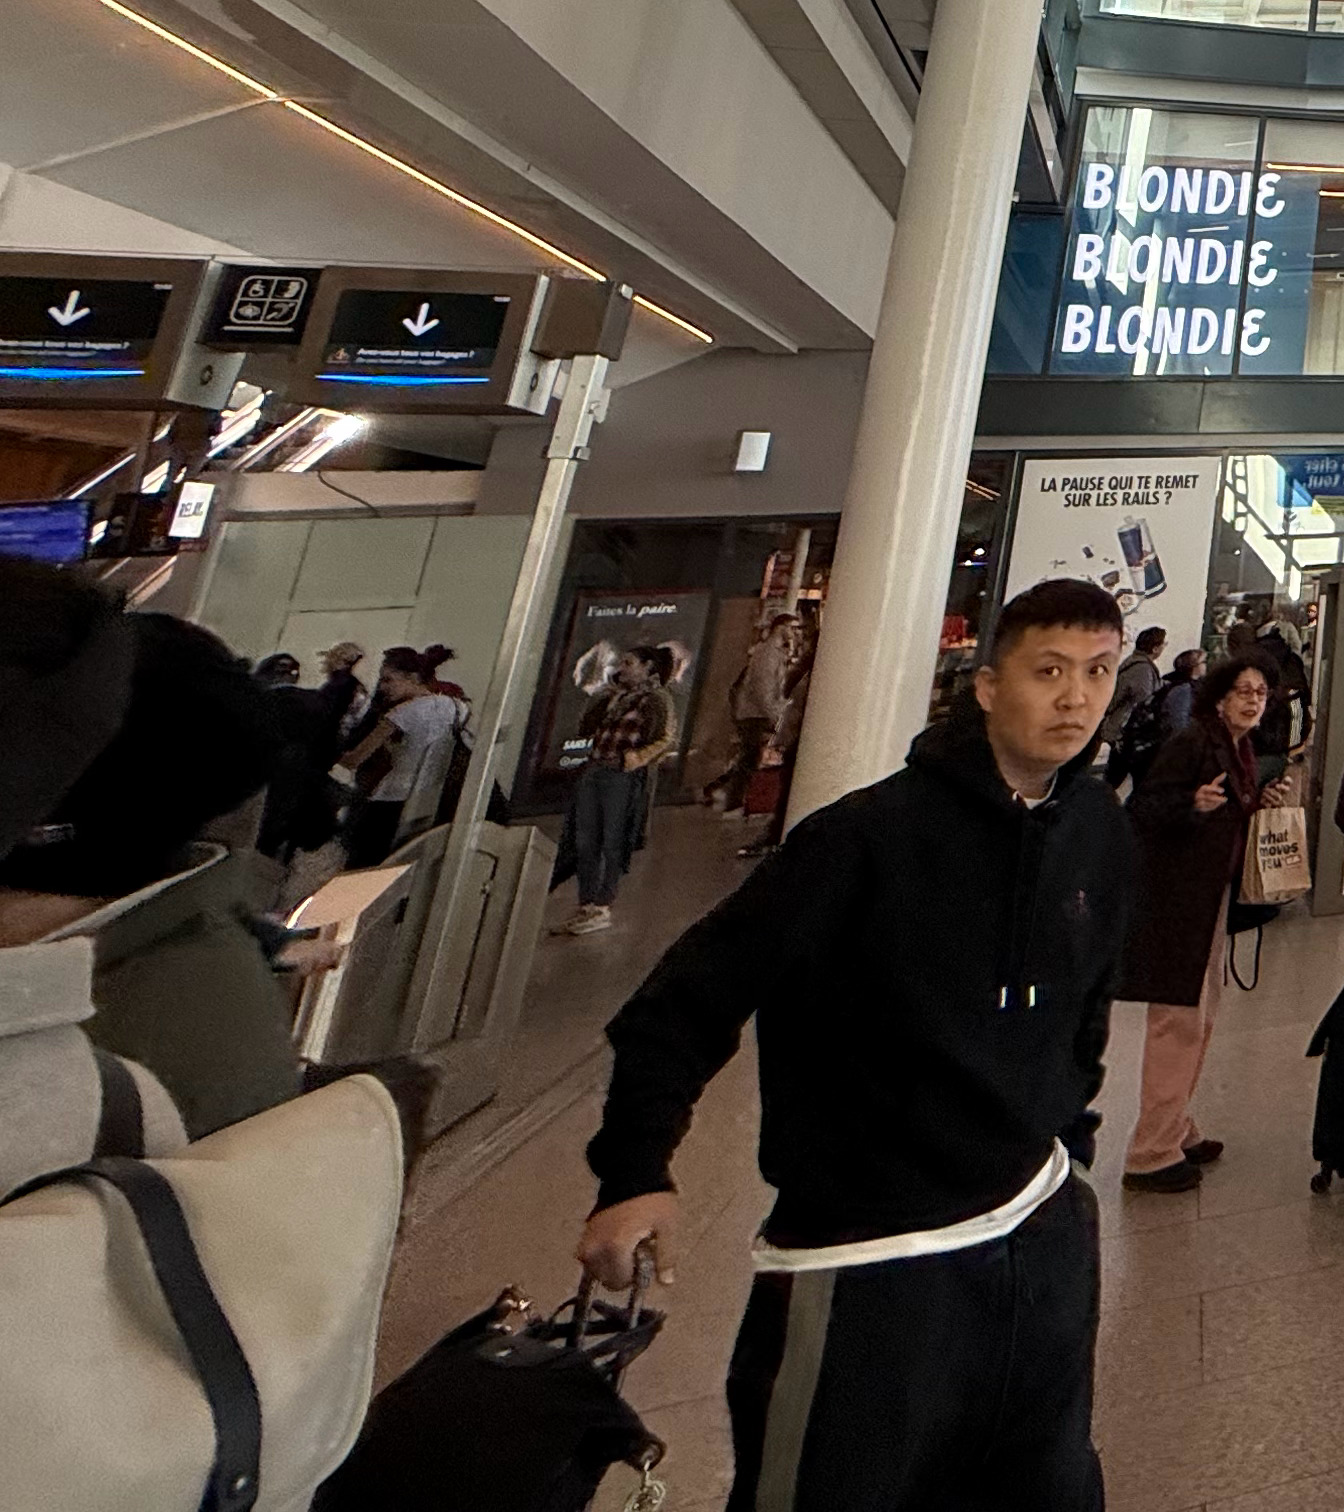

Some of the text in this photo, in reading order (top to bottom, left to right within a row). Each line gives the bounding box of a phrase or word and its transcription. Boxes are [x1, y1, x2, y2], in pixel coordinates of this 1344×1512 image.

[1040, 474, 1199, 492] LA PAUSE QUI TE REMET
[1063, 490, 1173, 507] SUR LES RAILS ?
[626, 603, 636, 615] la
[1259, 829, 1289, 846] what
[1259, 842, 1299, 857] moves
